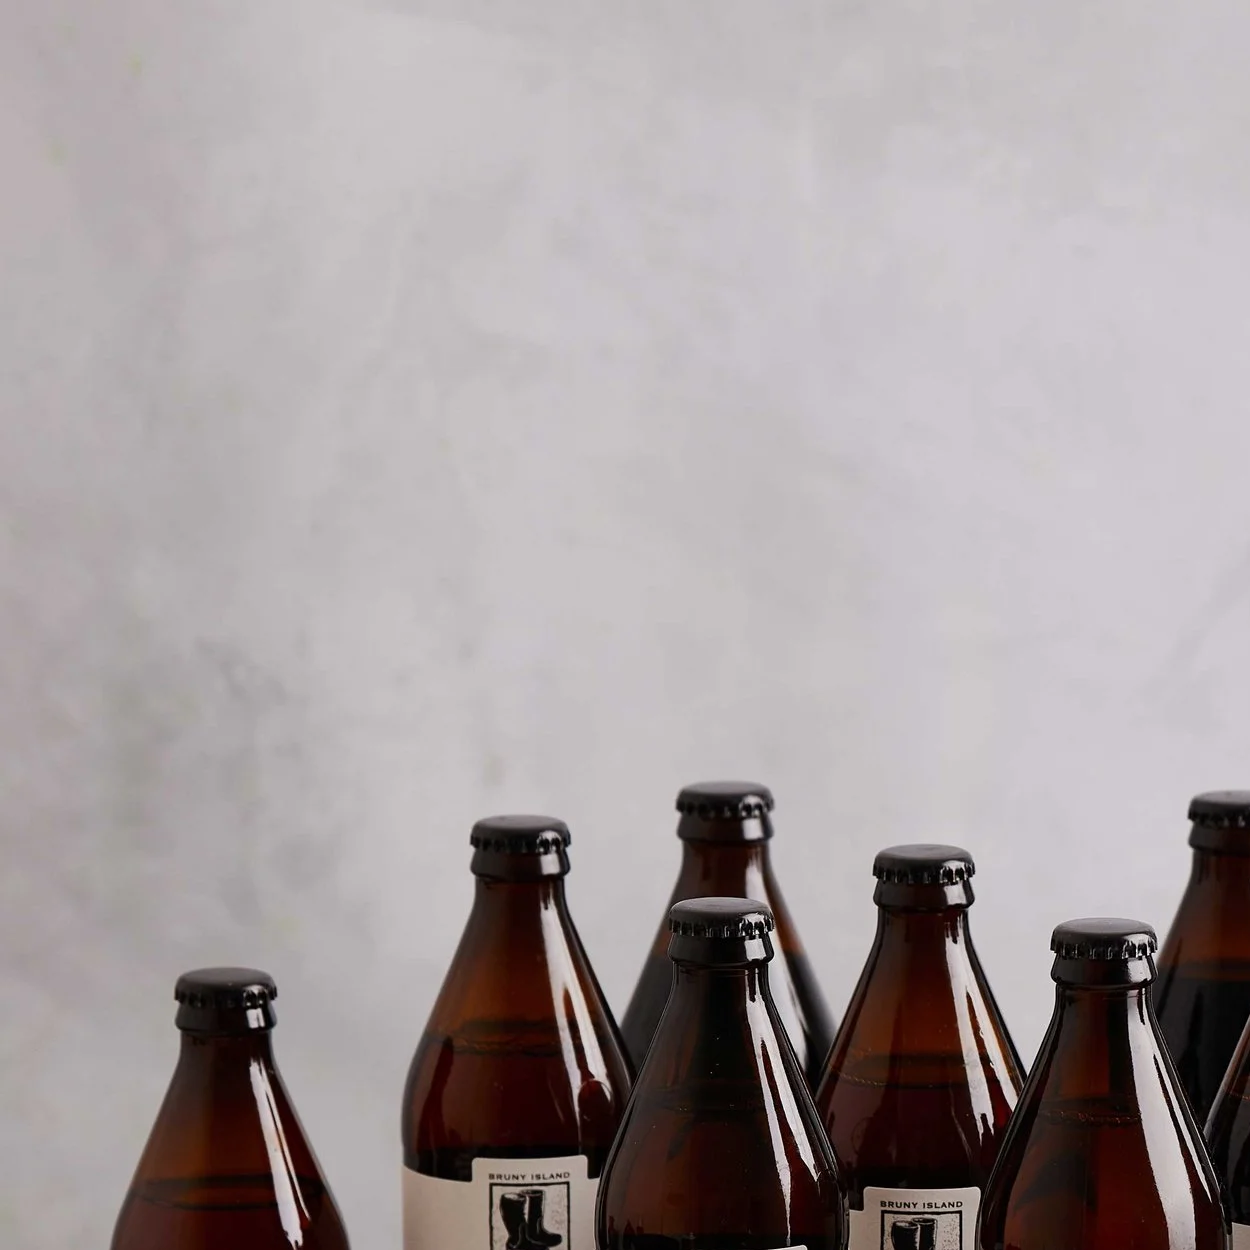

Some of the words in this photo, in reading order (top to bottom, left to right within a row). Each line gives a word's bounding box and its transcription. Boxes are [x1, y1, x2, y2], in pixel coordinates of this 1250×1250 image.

[531, 1172, 570, 1180] ISLAND
[880, 1201, 918, 1209] BRUNY
[923, 1201, 963, 1209] ISLAND
